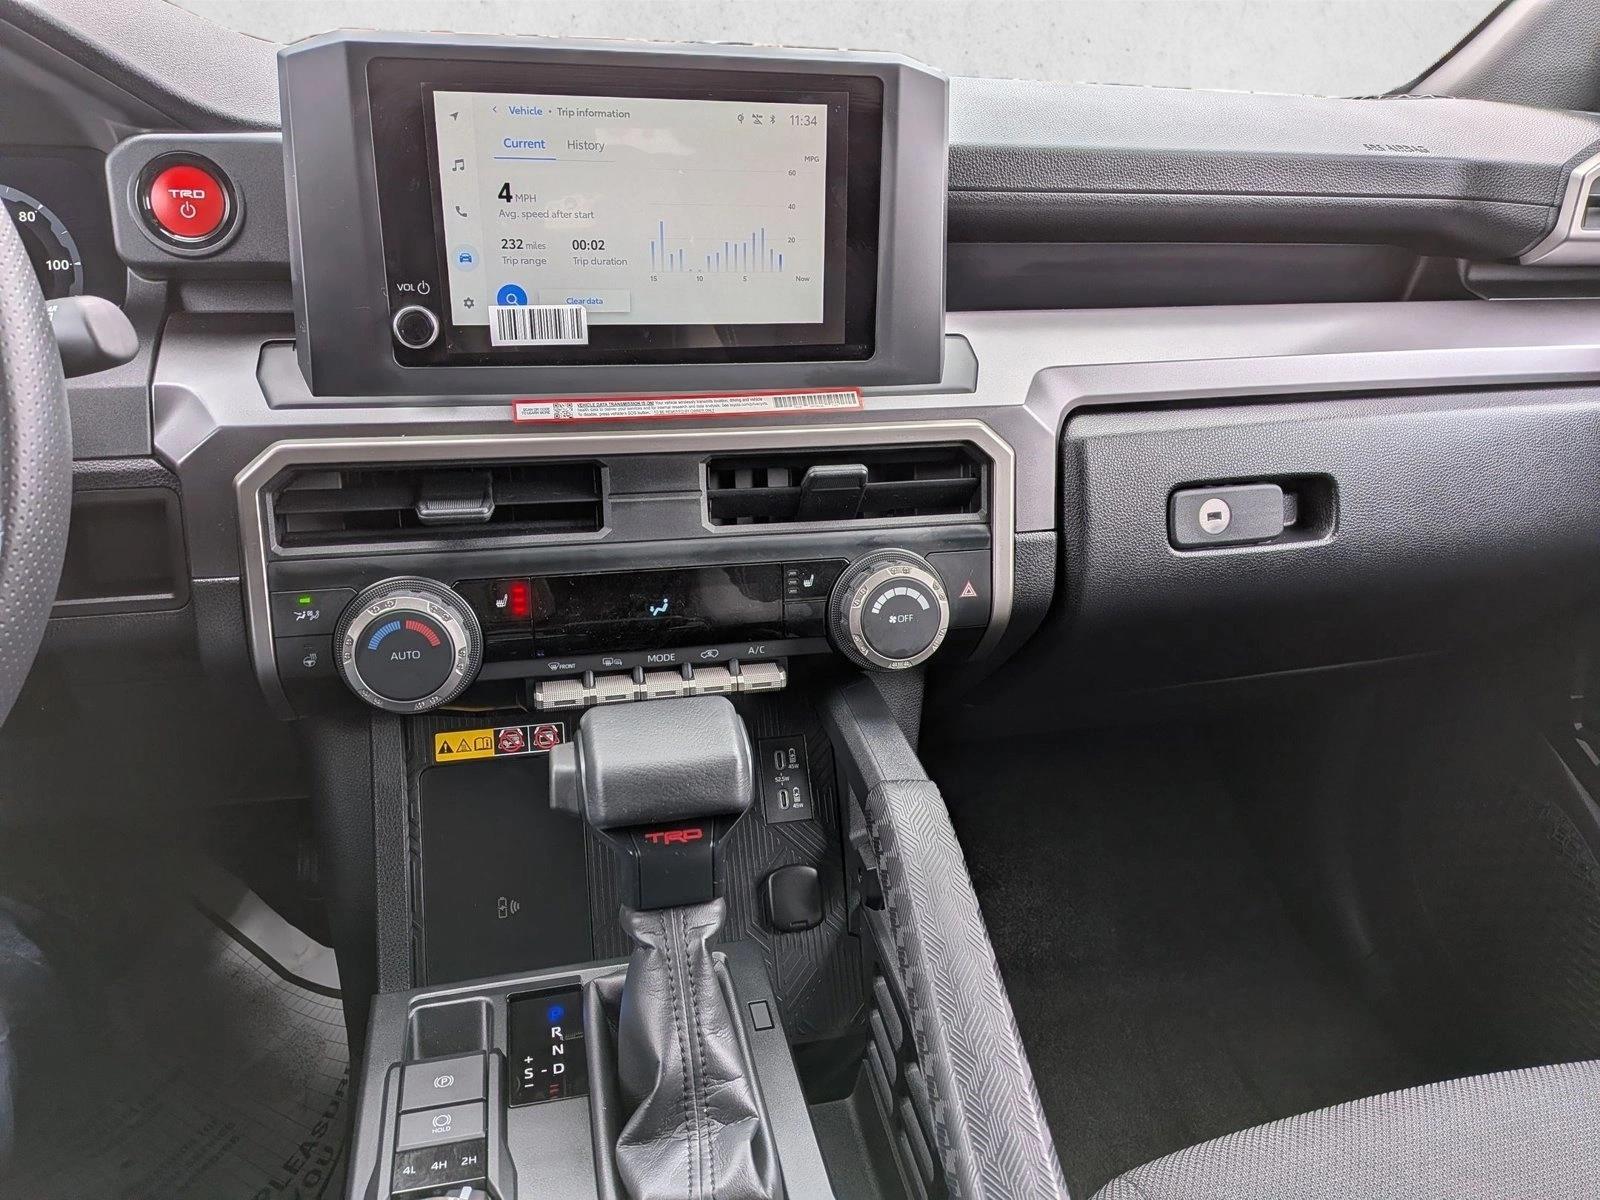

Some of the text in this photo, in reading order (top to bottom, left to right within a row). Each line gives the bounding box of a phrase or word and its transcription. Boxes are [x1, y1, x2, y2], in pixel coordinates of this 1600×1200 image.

[508, 105, 630, 119] Vehicle Trip information
[790, 114, 818, 126] 11:34
[503, 138, 546, 150] Current
[567, 140, 605, 152] History
[168, 189, 205, 199] TRD
[498, 182, 536, 203] 4 MPH
[18, 212, 36, 222] 80
[498, 209, 594, 221] Avg. speed after start
[500, 238, 546, 250] 232 miles
[572, 239, 605, 251] 00:02
[46, 260, 69, 270] 100
[502, 256, 547, 268] Trip range
[573, 257, 628, 268] Trip duration
[396, 283, 416, 291] VOL
[566, 296, 604, 306] Clear data
[390, 650, 421, 661] AUTO
[748, 646, 765, 654] A/C
[648, 653, 676, 662] MODE
[645, 828, 703, 844] TRD
[552, 1026, 563, 1038] R
[552, 1044, 564, 1056] N
[524, 1068, 534, 1080] S
[553, 1063, 565, 1074] D
[430, 1160, 448, 1170] 4H
[461, 1155, 477, 1165] 2H
[403, 1166, 416, 1175] 4L
